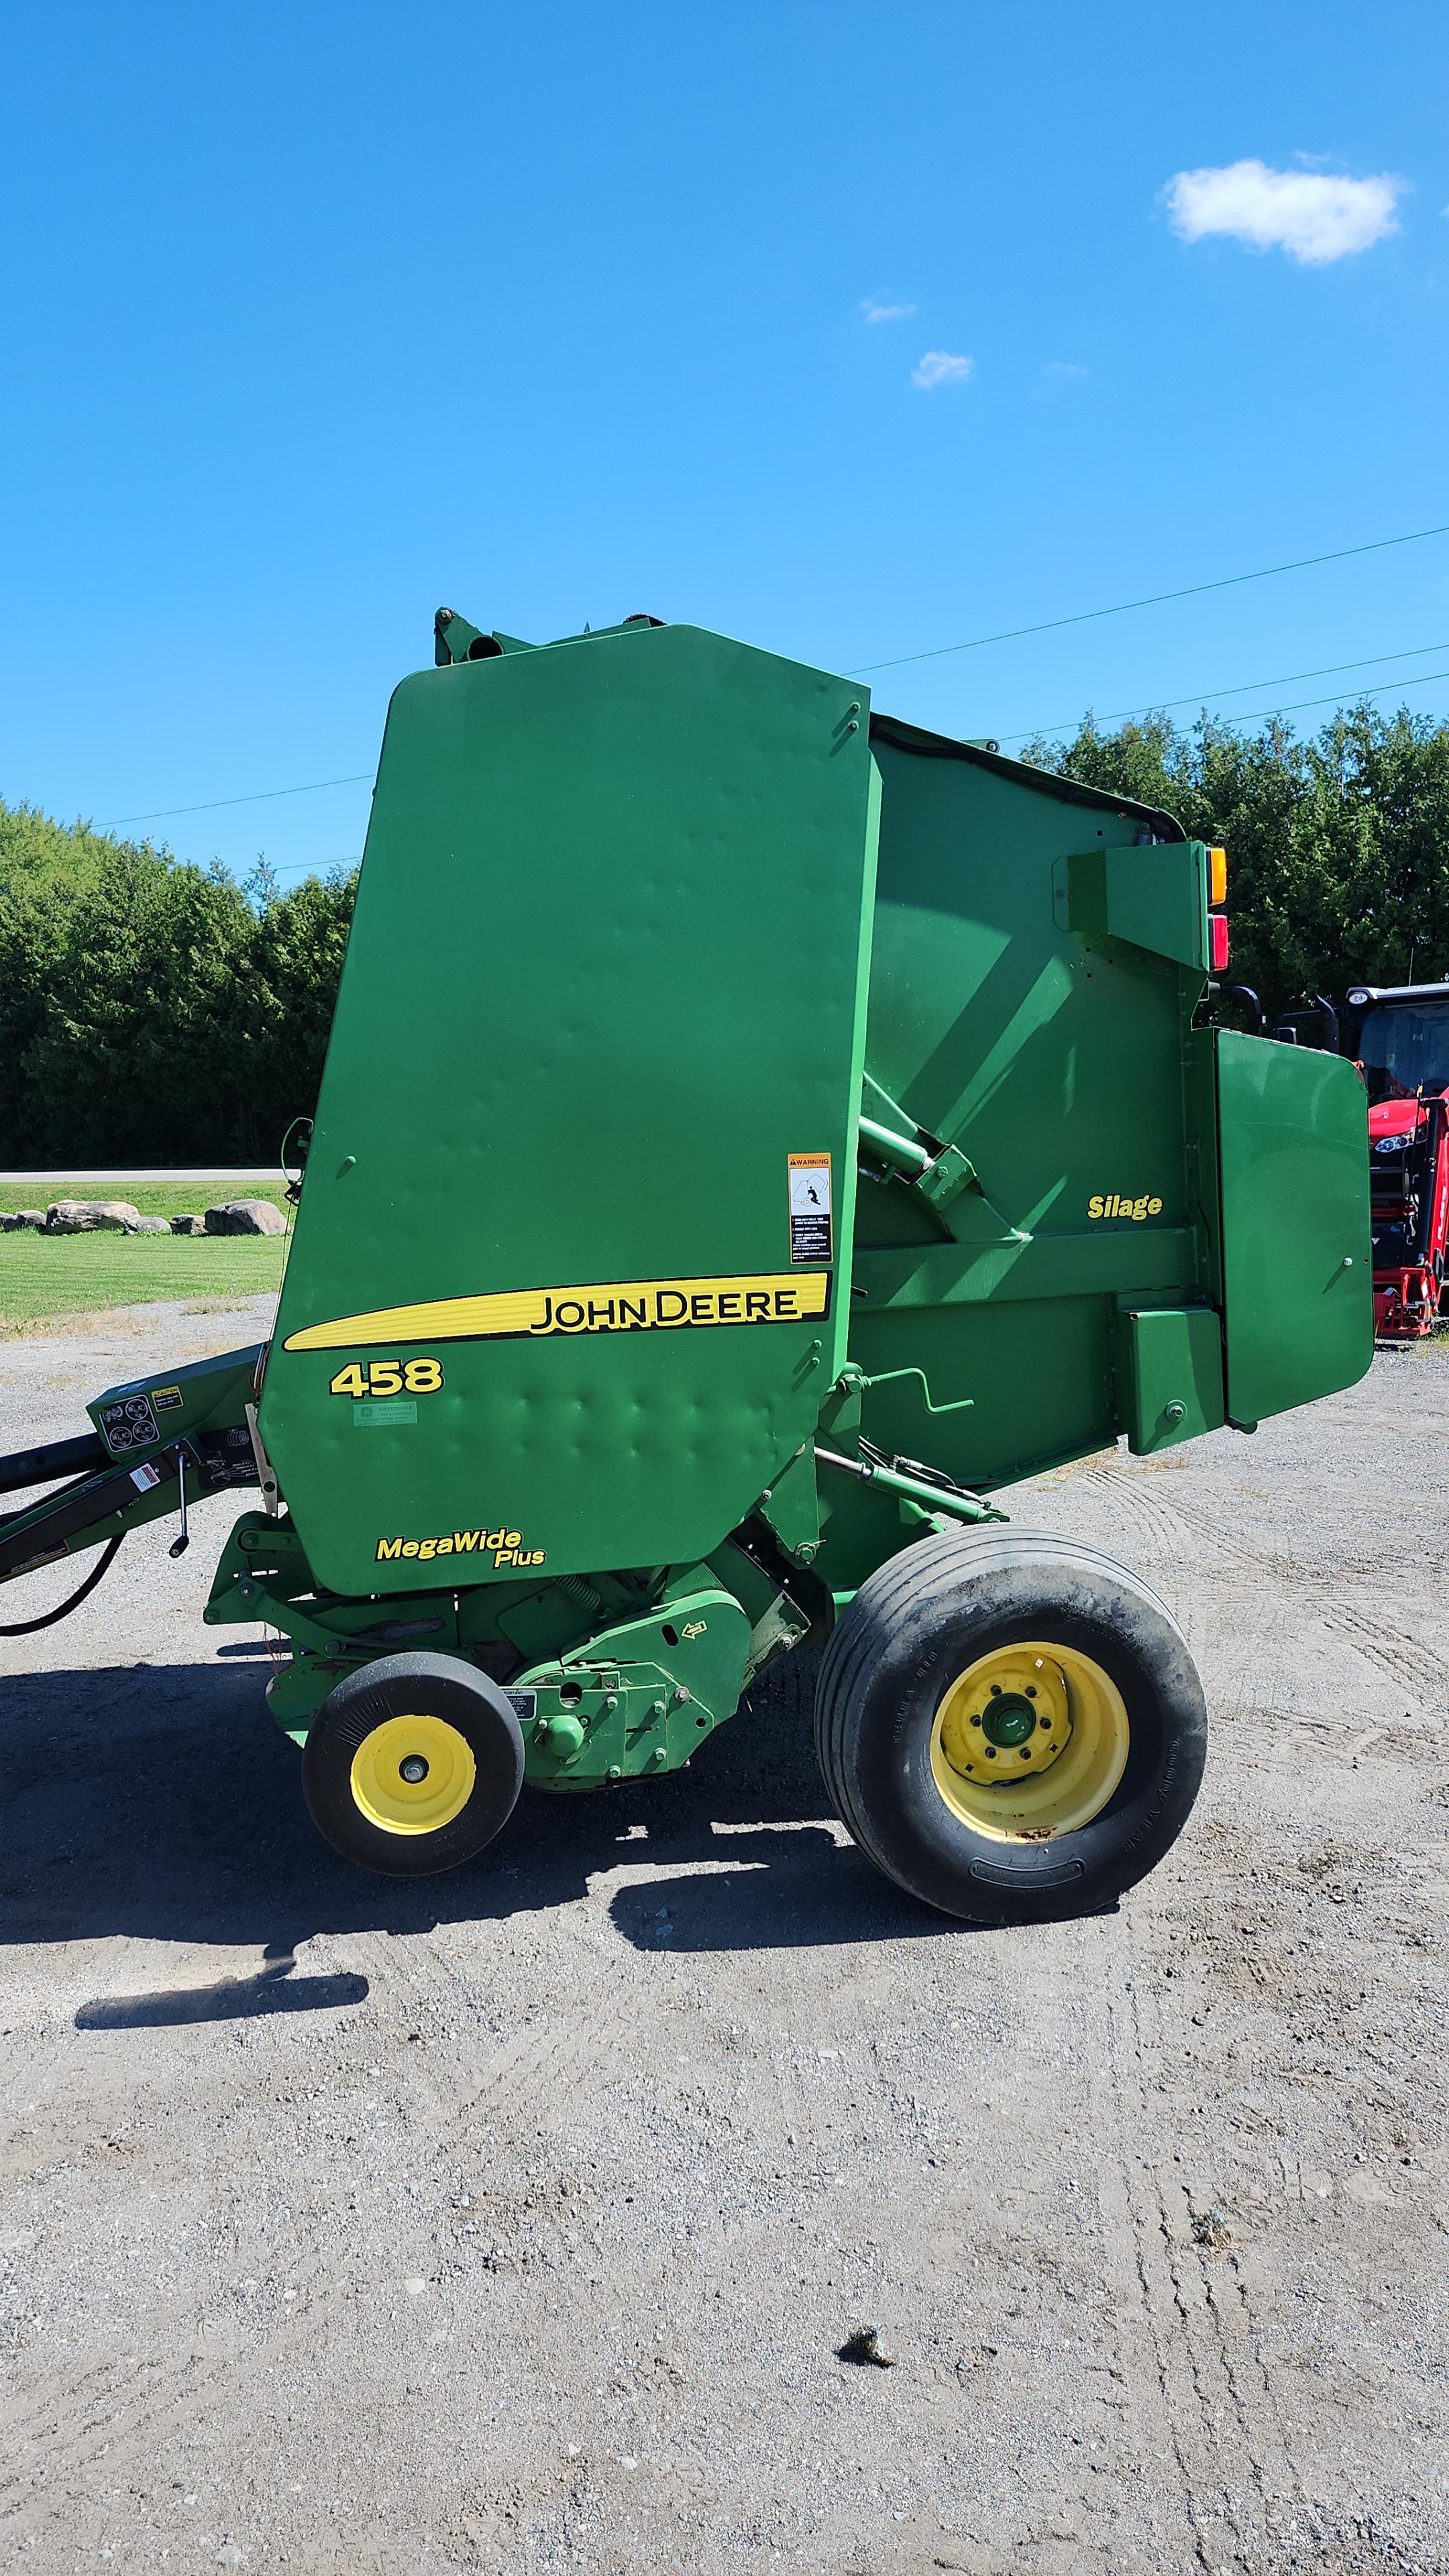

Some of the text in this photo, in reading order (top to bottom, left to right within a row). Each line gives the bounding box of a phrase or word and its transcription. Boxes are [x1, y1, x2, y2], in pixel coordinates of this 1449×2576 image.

[1087, 1195, 1163, 1220] Silage
[531, 1290, 798, 1329] JOHN DEERE
[158, 1387, 178, 1395] CAUTION
[331, 1358, 443, 1397] 458
[376, 1529, 522, 1560] MegaWide
[494, 1550, 545, 1568] Plus
